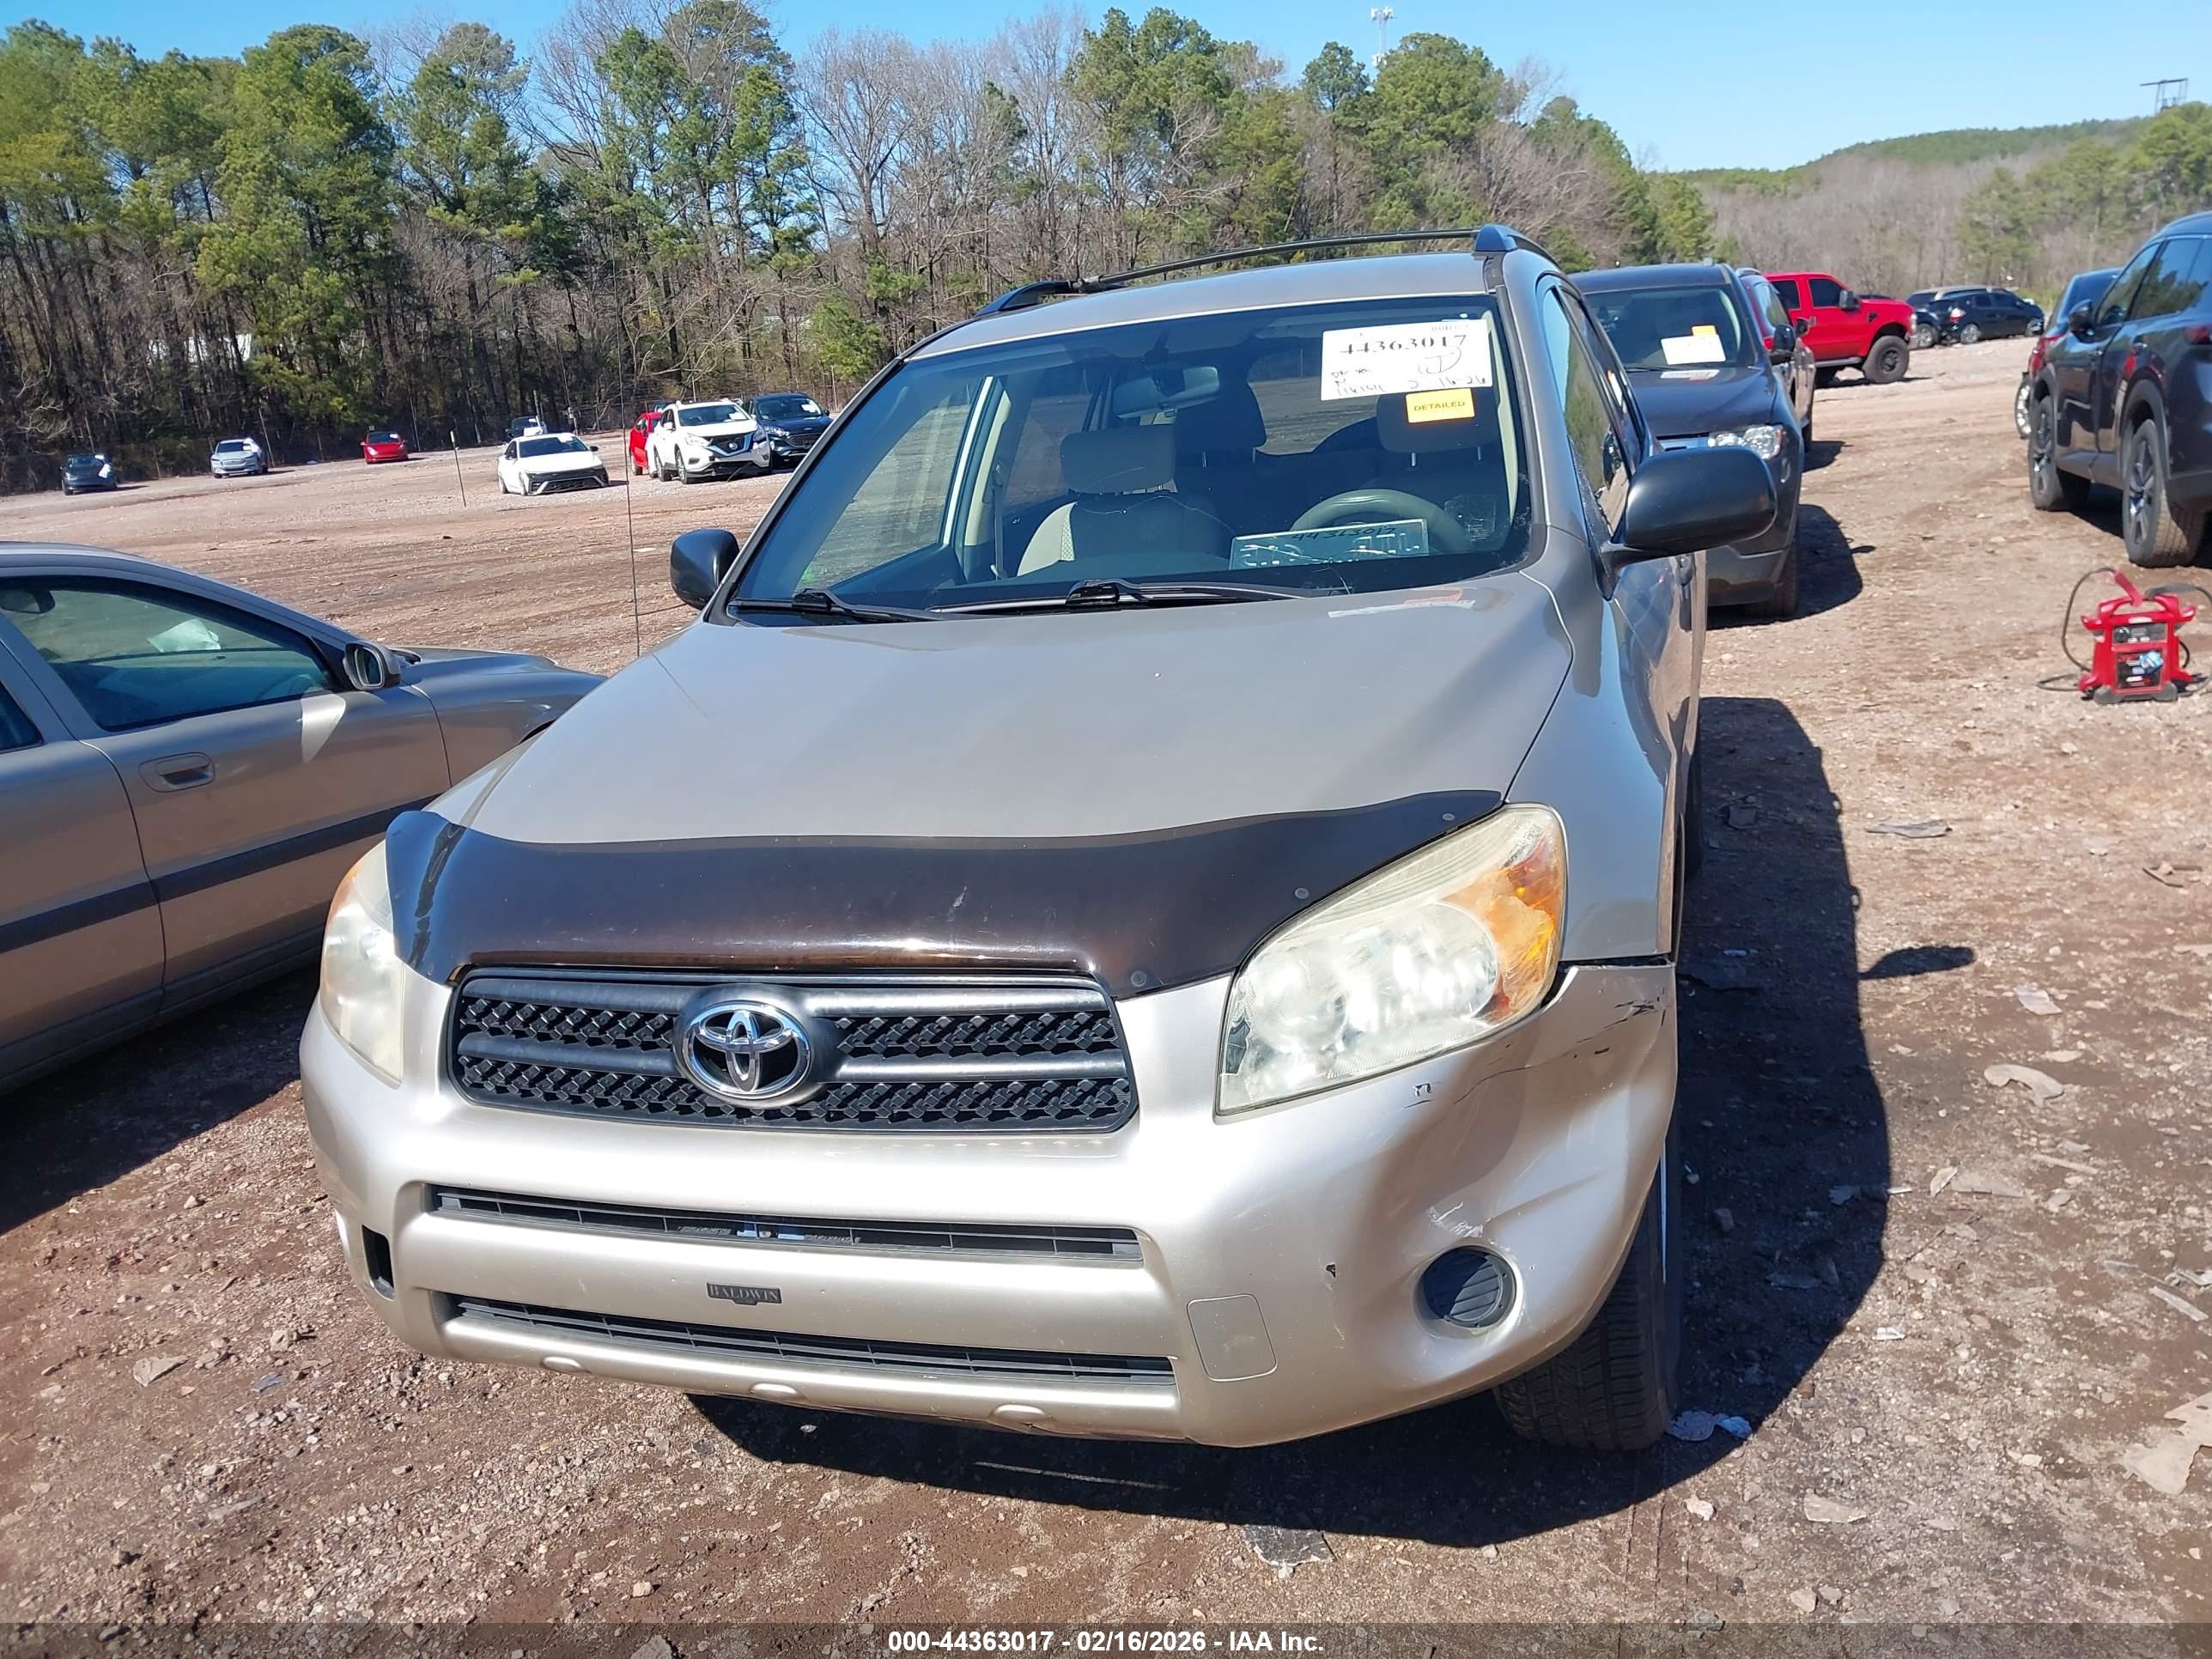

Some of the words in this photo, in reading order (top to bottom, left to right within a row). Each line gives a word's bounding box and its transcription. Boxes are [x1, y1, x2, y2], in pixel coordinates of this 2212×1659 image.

[1340, 334, 1467, 355] 44363017
[1413, 400, 1466, 411] DETAILED
[708, 1284, 780, 1302] BALDWIN
